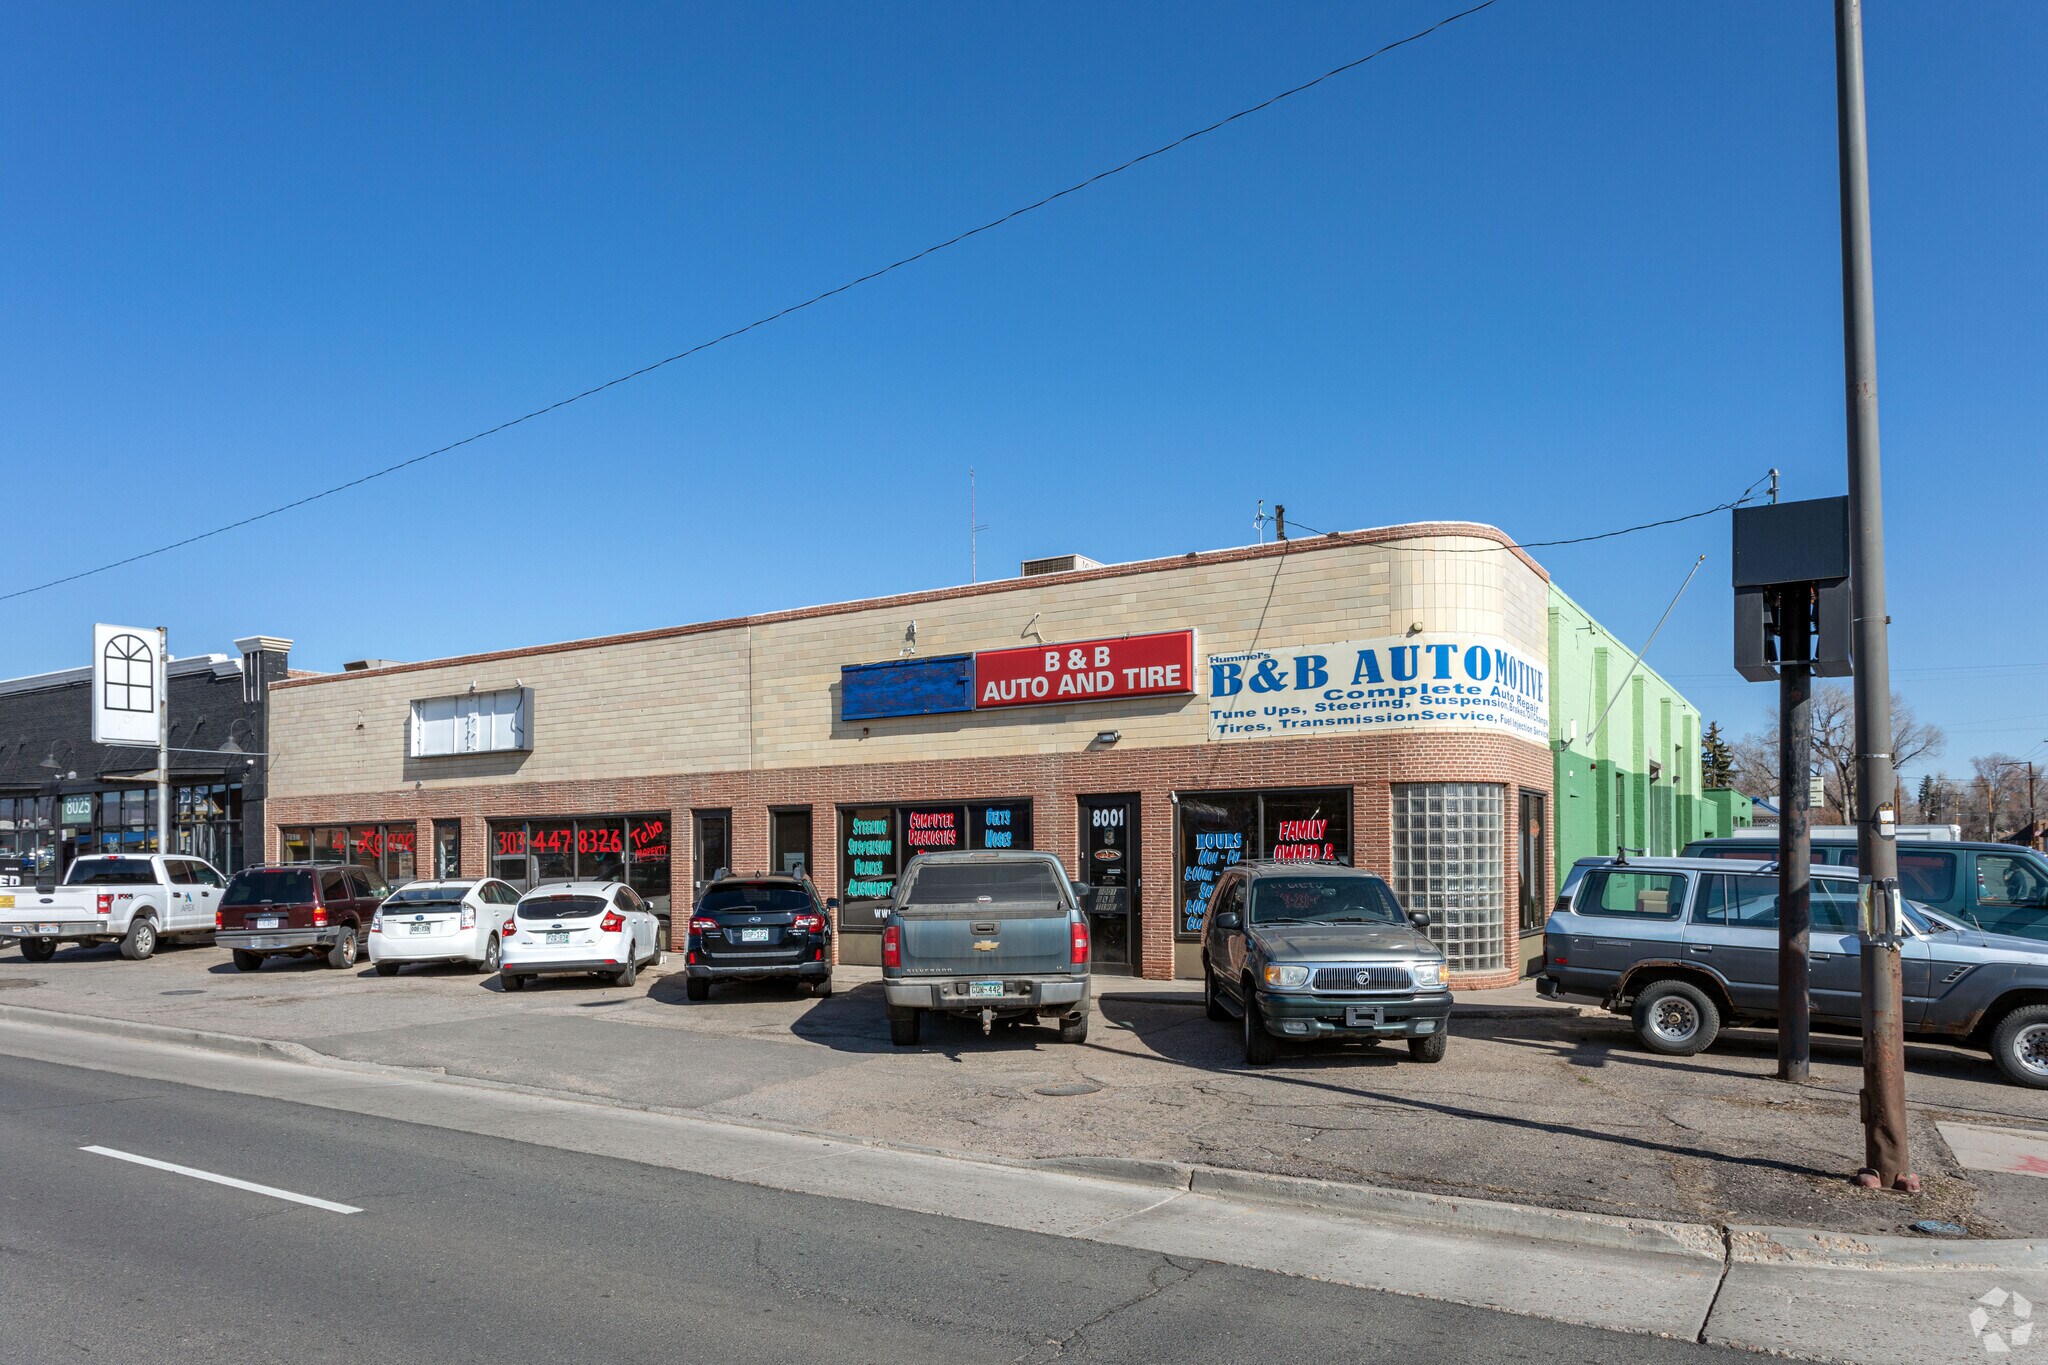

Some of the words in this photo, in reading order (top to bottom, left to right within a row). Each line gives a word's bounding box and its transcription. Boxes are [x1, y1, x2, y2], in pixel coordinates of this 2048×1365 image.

[1045, 652, 1060, 672] B
[1067, 649, 1087, 670] &
[1095, 646, 1110, 668] B
[1210, 652, 1270, 664] Hummel's
[983, 676, 1049, 702] AUTO
[1057, 671, 1115, 696] AND
[1123, 664, 1181, 690] TIRE
[1351, 644, 1544, 702] AUTOMOTIVE
[1210, 710, 1257, 720] Tune
[1264, 706, 1307, 717] Ups,
[1314, 698, 1410, 712] Steering,
[1324, 683, 1482, 700] Complete
[1490, 686, 1514, 702] Auto
[1516, 694, 1539, 714] Repair
[1216, 724, 1272, 734] Tires,
[66, 798, 90, 814] 8025
[909, 811, 955, 829] COMPUTER
[1092, 808, 1124, 826] 8001
[630, 821, 662, 848] Tebo
[908, 830, 956, 846] DIAGNOSTICS
[1278, 819, 1328, 841] FAMILY
[332, 832, 345, 854] 4
[357, 830, 415, 857] Lease
[1196, 832, 1242, 850] HOURS
[1274, 844, 1320, 864] OWNED
[1322, 843, 1334, 864] &
[181, 904, 195, 912] APEX
